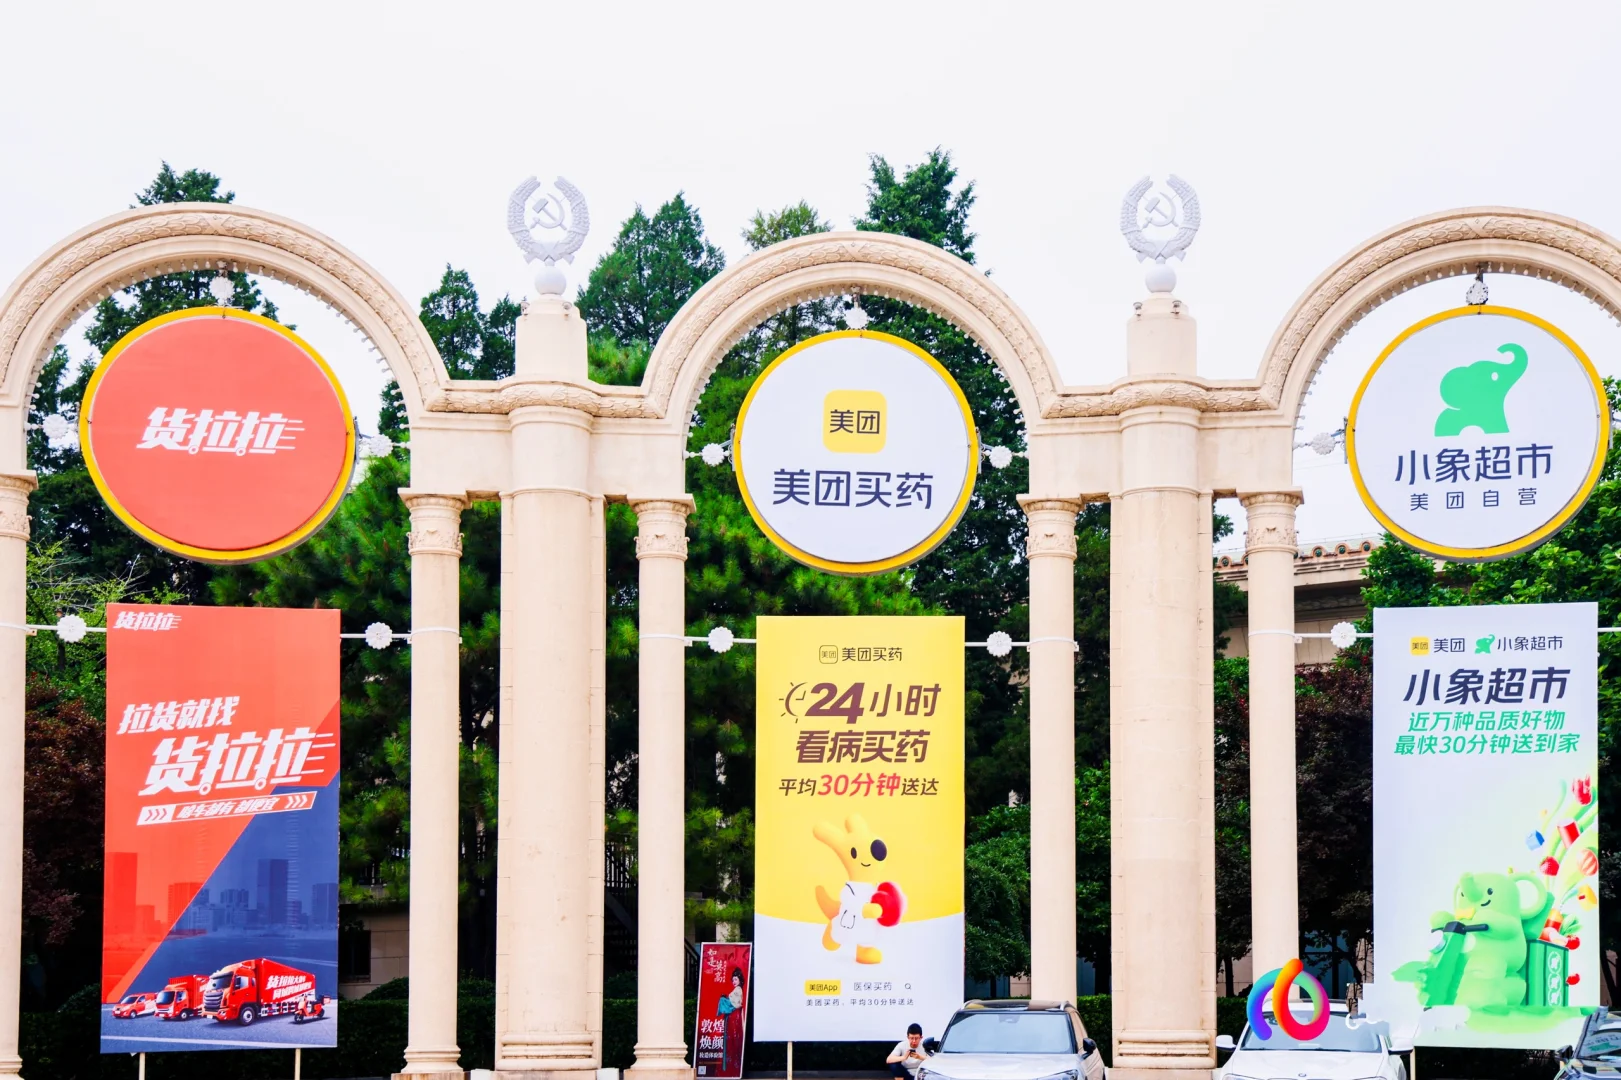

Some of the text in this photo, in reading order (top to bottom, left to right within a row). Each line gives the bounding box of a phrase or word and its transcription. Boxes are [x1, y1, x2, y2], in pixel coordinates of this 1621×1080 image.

[136, 407, 305, 456] 货拉拉
[830, 409, 880, 434] 美团
[1395, 443, 1553, 485] 小象超市
[773, 468, 933, 509] 美团买药
[1410, 488, 1537, 511] 美团自营
[113, 611, 182, 631] 货拉拉
[821, 647, 903, 662] 美团 美团买药
[1433, 638, 1465, 653] 美团
[1497, 636, 1563, 651] 小象超市
[1403, 667, 1571, 706] 小象超市
[804, 682, 941, 724] 24小时
[116, 696, 240, 735] 拉货就找
[1408, 710, 1566, 732] 近万种品质好物
[796, 730, 931, 763] 看病买药
[1394, 733, 1580, 755] 最快30分钟送到家
[138, 727, 336, 796] 货拉拉
[778, 773, 939, 797] 平均30分钟送达
[809, 981, 892, 992] 美团App 医保买药
[701, 1018, 725, 1033] 敦煌
